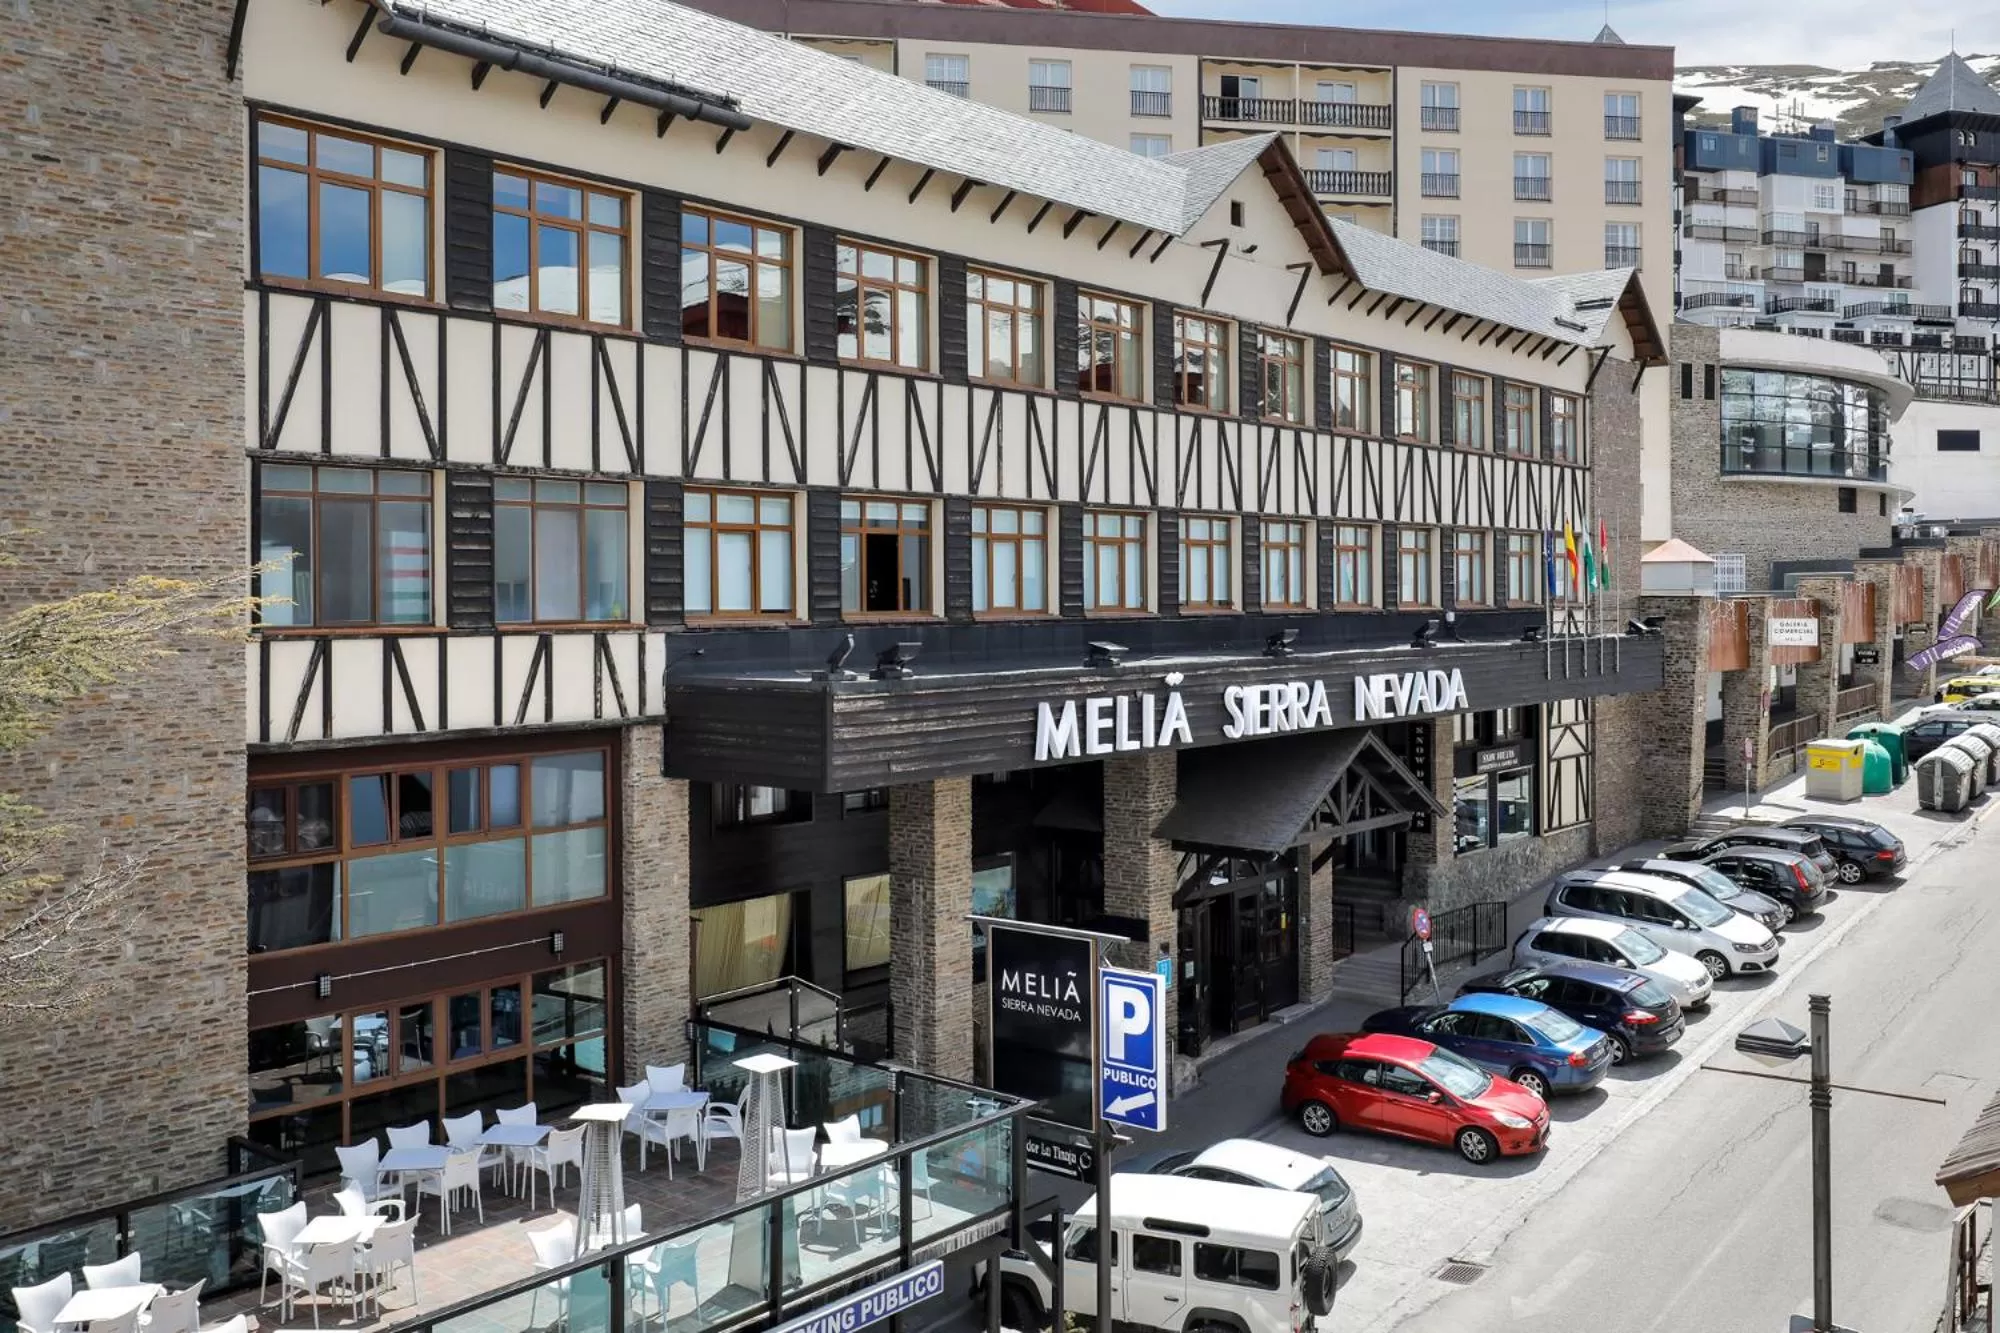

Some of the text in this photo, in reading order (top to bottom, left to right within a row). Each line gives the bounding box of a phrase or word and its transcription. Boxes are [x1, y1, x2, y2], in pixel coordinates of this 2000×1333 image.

[1223, 680, 1333, 739] SIERRA
[1355, 668, 1469, 721] NEVADA
[1001, 996, 1082, 1022] SIERRA NEVADA
[1108, 983, 1150, 1061] P
[1103, 1066, 1157, 1090] PUBLICO
[860, 1269, 940, 1323] PUBLICO
